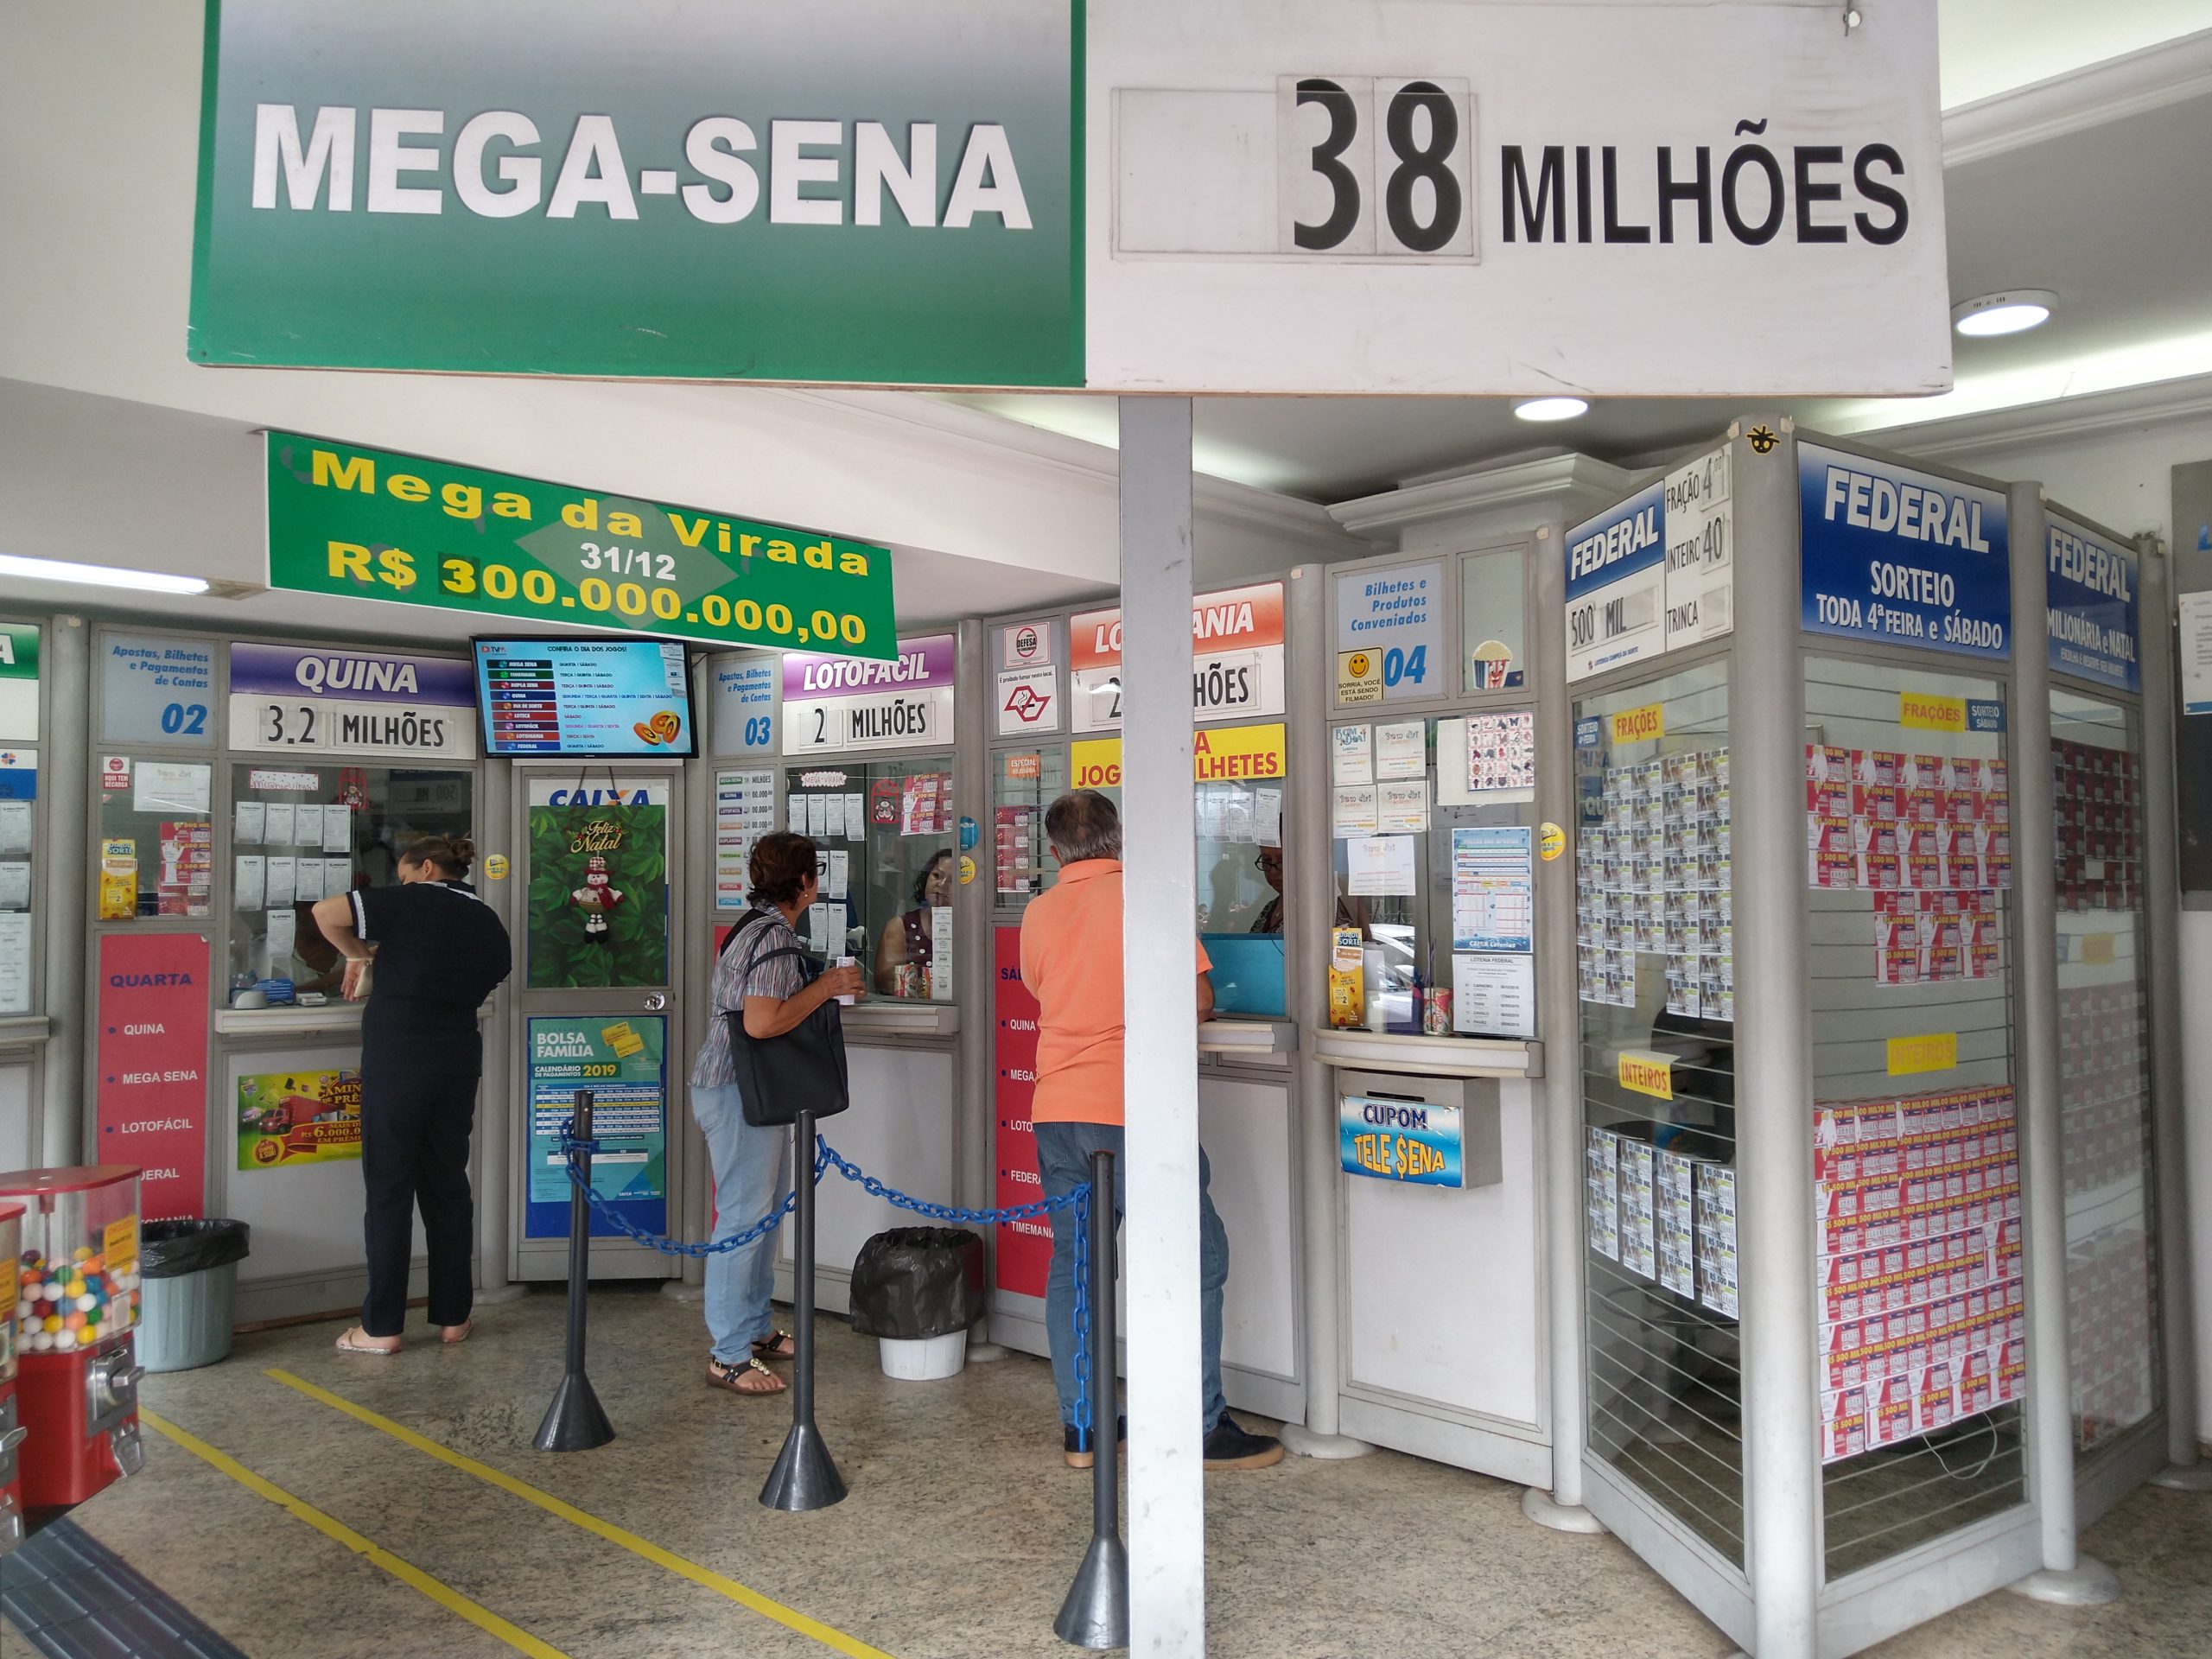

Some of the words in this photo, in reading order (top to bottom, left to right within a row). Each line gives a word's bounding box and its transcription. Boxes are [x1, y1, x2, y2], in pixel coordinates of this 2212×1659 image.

[251, 103, 1033, 230] MEGA-SENA
[1294, 79, 1462, 252] 38
[1501, 118, 1909, 246] MILHÕES
[1667, 471, 1700, 513] FRAÇÃO
[312, 450, 532, 520] Mega
[562, 498, 643, 539] da
[667, 513, 869, 577] Virada
[1825, 465, 1989, 553] FEDERAL
[1570, 505, 1658, 581] FEDERAL
[580, 543, 676, 581] 31/12
[2050, 525, 2130, 602] FEDERAL
[327, 540, 417, 588] R$
[441, 558, 866, 645] 300.000.000,00
[1365, 580, 1414, 596] Bilhetes
[1420, 579, 1427, 588] e
[1871, 560, 1955, 607] SORTEIO
[1372, 596, 1427, 612] Produtos
[1351, 612, 1427, 631] Conveniados
[1571, 605, 1594, 647] 500
[1606, 597, 1626, 638] MIL
[1668, 601, 1698, 634] TRINCA
[1816, 594, 1862, 629] TODA
[1929, 621, 1938, 640] e
[1944, 609, 2003, 649] SÁBADO
[1017, 638, 1036, 648] DEFESA
[2047, 607, 2101, 652] MILIONÁRIA
[2109, 630, 2135, 662] NATAL
[112, 646, 161, 660] Apostas,
[165, 650, 208, 662] Bilhetes
[140, 662, 208, 675] Pagamentos
[296, 656, 418, 694] QUINA
[719, 672, 744, 683] Apostas,
[747, 669, 771, 678] Bilhetes
[1384, 645, 1427, 687] 04
[156, 676, 168, 685] de
[173, 677, 207, 688] Contas
[733, 682, 771, 692] Pagamentos
[1194, 662, 1249, 707] HÕES
[741, 694, 748, 702] de
[162, 703, 207, 734] 02
[815, 708, 825, 744] 2
[852, 699, 925, 739] MILHÕES
[1904, 702, 1961, 722] FRAÇÕES
[267, 704, 316, 745] 3.2
[342, 712, 444, 747] MILHÕES
[746, 716, 771, 746] 03
[1617, 709, 1657, 741] FRAÇÕES
[1011, 758, 1036, 767] ESPECIAL
[1198, 753, 1277, 779] LHETES
[550, 790, 650, 805] CAIXA
[586, 821, 614, 836] Feliz
[570, 833, 622, 854] Natal
[110, 973, 192, 988] QUARTA
[124, 1024, 164, 1035] QUINA
[1010, 1020, 1036, 1031] QUINA
[537, 1033, 587, 1045] BOLSA
[537, 1044, 594, 1058] FAMÍLIA
[1891, 1040, 1953, 1066] INTEIROS
[123, 1071, 162, 1084] MEGA
[163, 1070, 197, 1083] SENA
[535, 1064, 581, 1073] CALENDÁRIO
[583, 1065, 616, 1077] 2019
[1010, 1070, 1034, 1081] MEGA
[1621, 1061, 1668, 1092] INTEIROS
[122, 1117, 193, 1134] LOTOFÁCIL
[1363, 1104, 1427, 1129] CUPOM
[1354, 1134, 1391, 1175] TELE
[1713, 1170, 1723, 1179] 500
[1724, 1173, 1733, 1182] MIL
[1718, 1276, 1726, 1285] 500
[1728, 1280, 1737, 1289] MIL
[1841, 1418, 1853, 1428] 500
